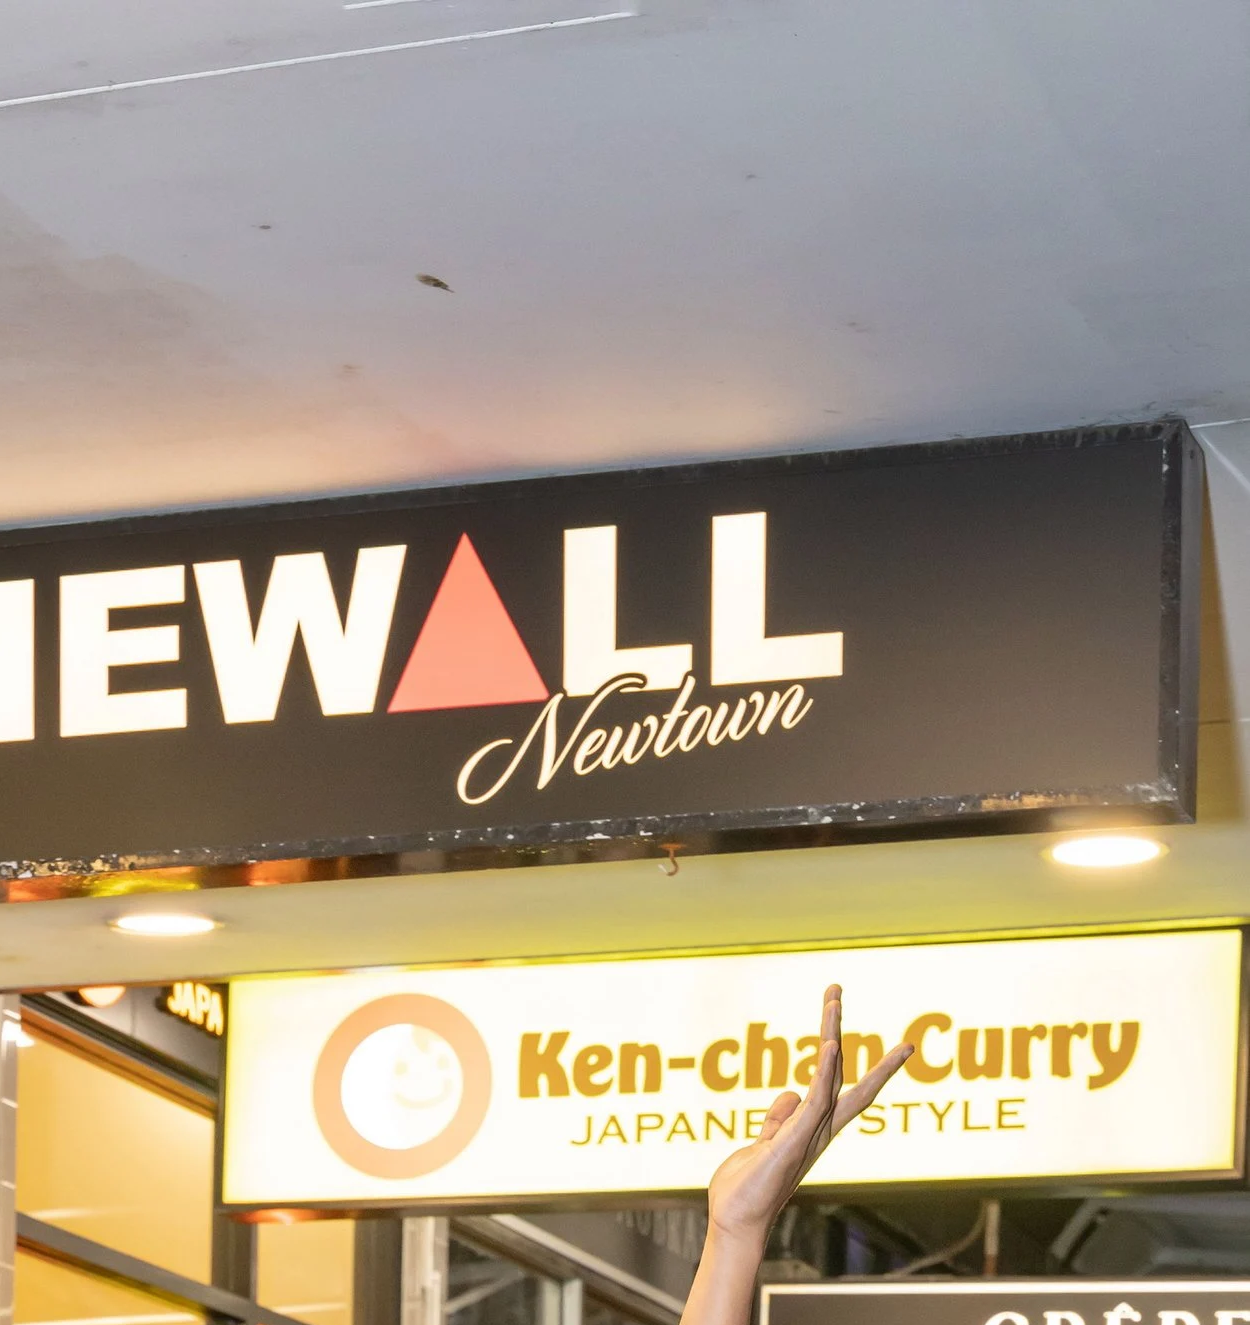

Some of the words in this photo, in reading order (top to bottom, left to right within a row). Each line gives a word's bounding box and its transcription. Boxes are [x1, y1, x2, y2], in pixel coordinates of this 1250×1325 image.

[457, 672, 814, 804] Newtown
[518, 1022, 884, 1098] Ken-chan
[902, 1012, 1141, 1091] Curry
[570, 1108, 766, 1146] JAPANE
[859, 1098, 1027, 1135] STYLE
